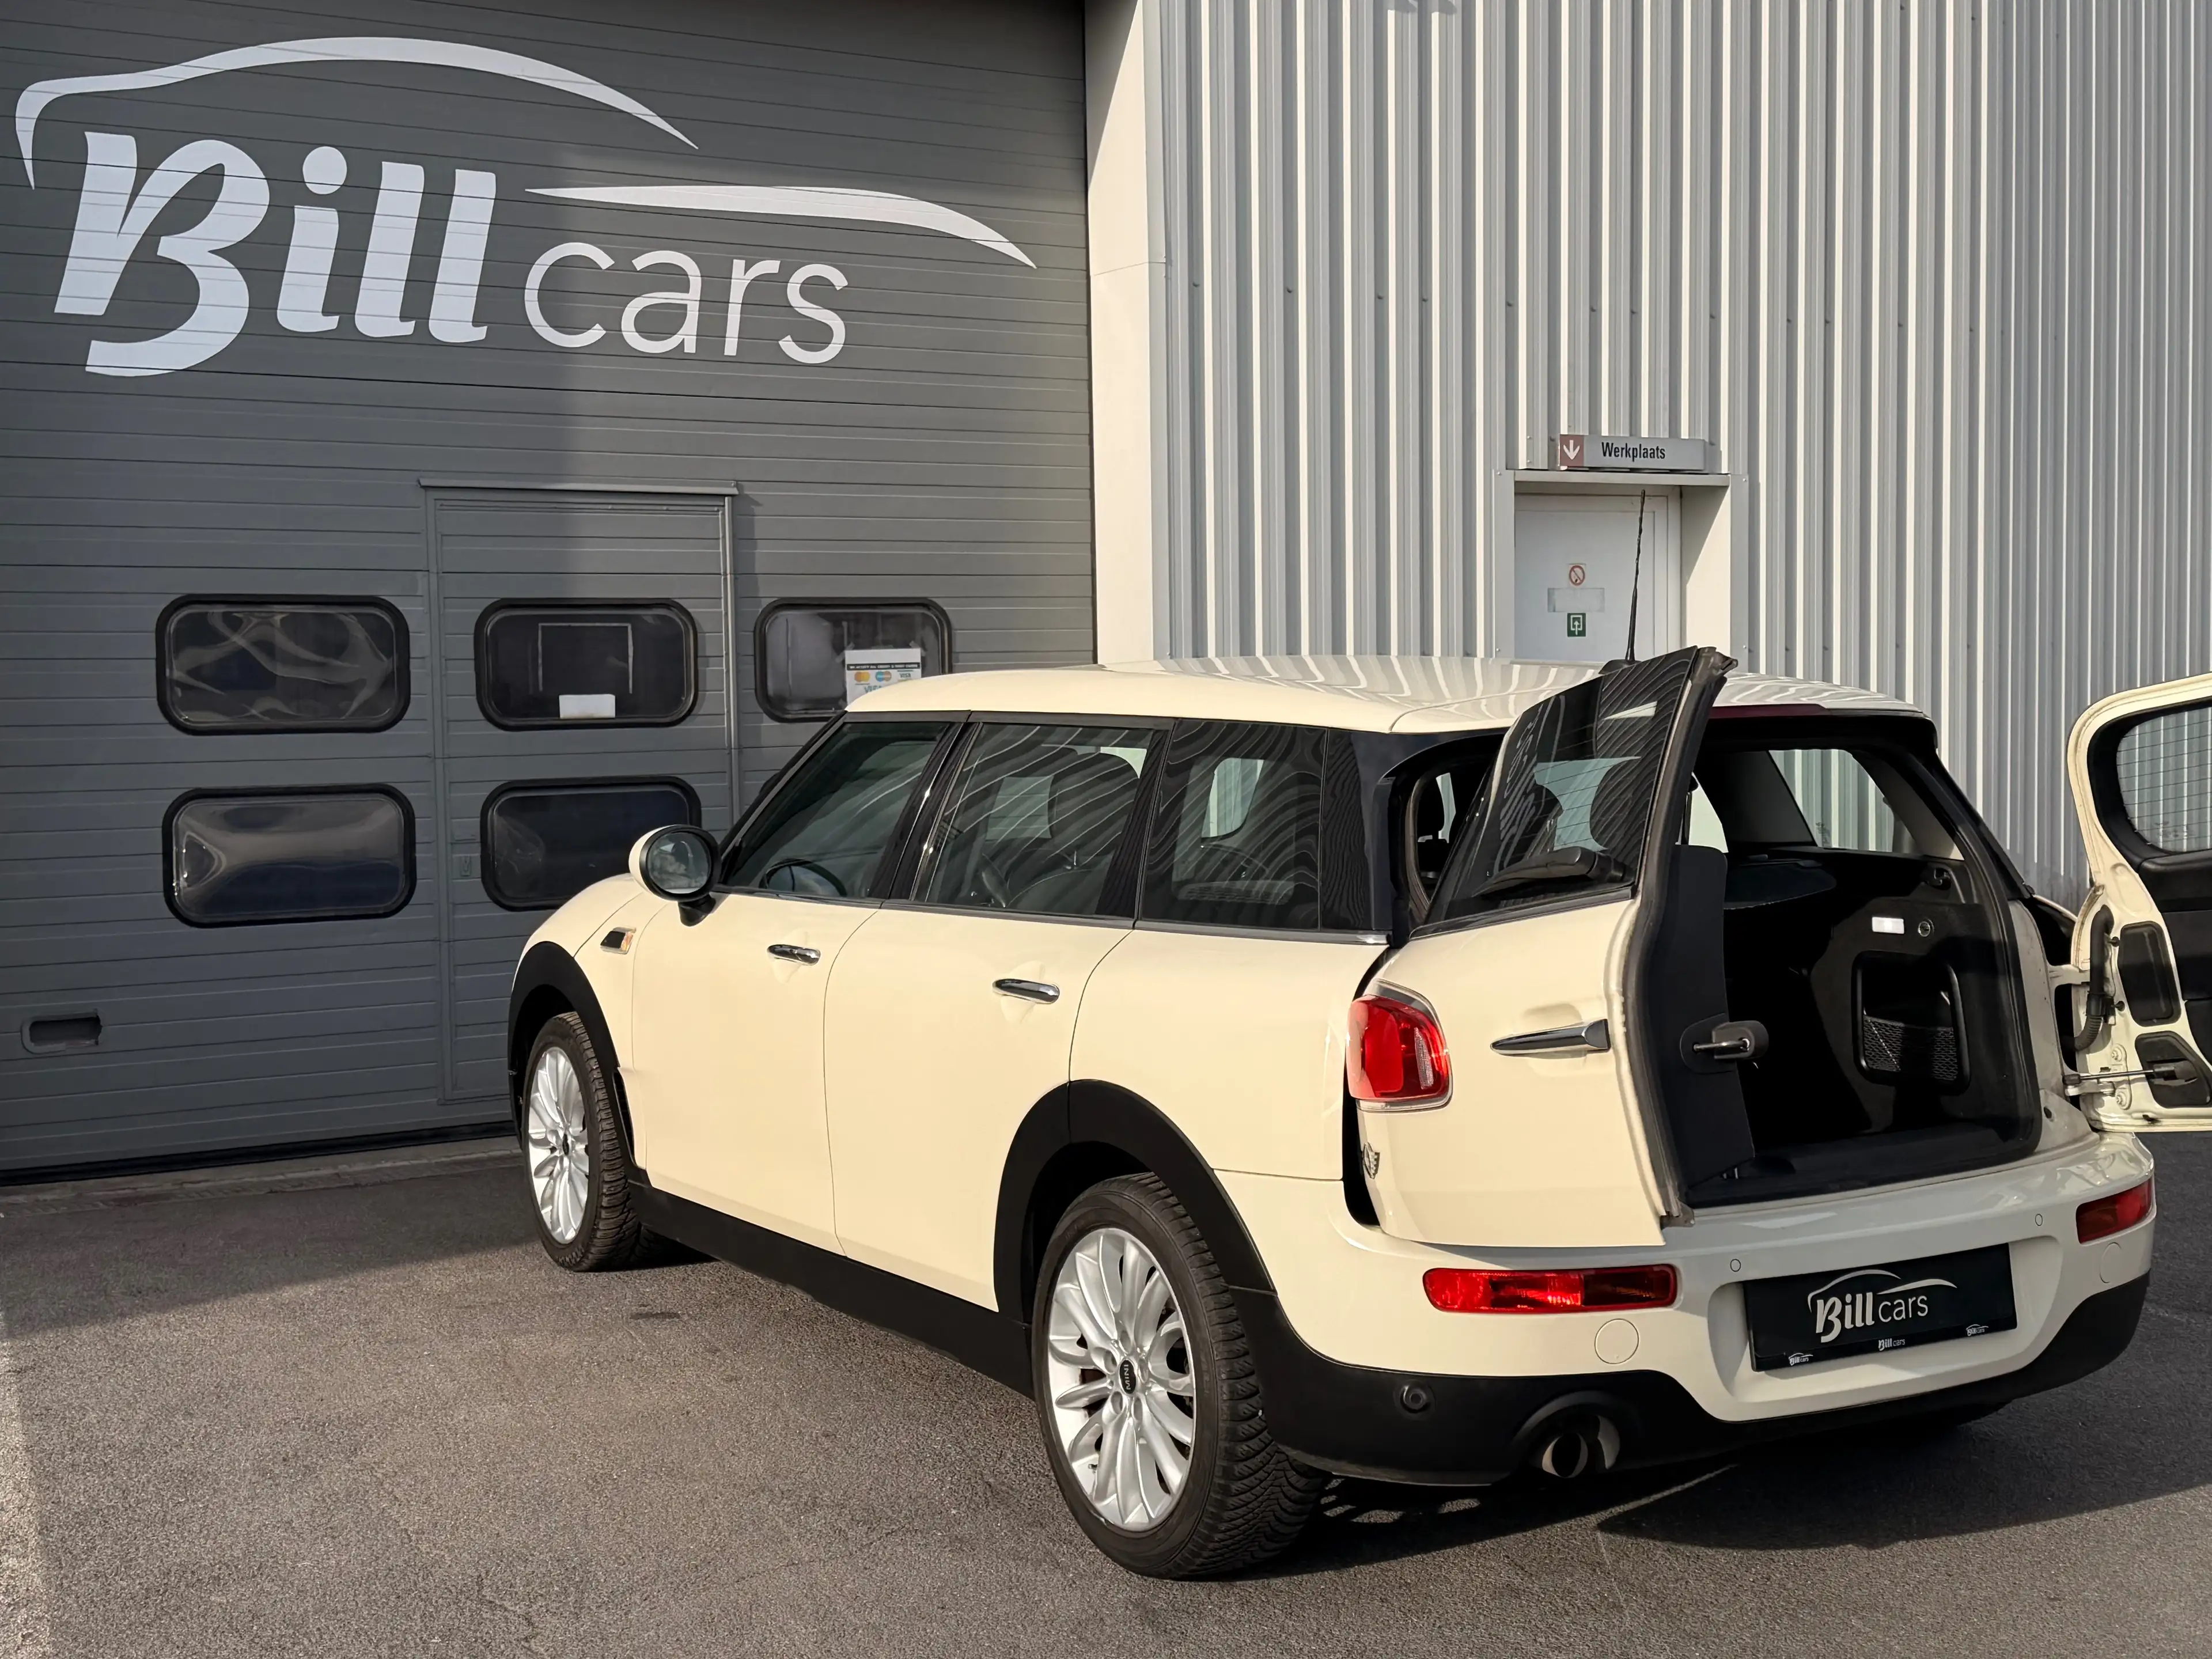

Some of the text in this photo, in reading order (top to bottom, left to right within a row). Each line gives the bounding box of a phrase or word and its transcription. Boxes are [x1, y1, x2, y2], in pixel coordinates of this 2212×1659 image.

[55, 132, 849, 376] Bill cars
[1601, 441, 1666, 463] Werkplaats
[1816, 1292, 1928, 1343] Bill cars
[1878, 1338, 1906, 1351] Bill cars
